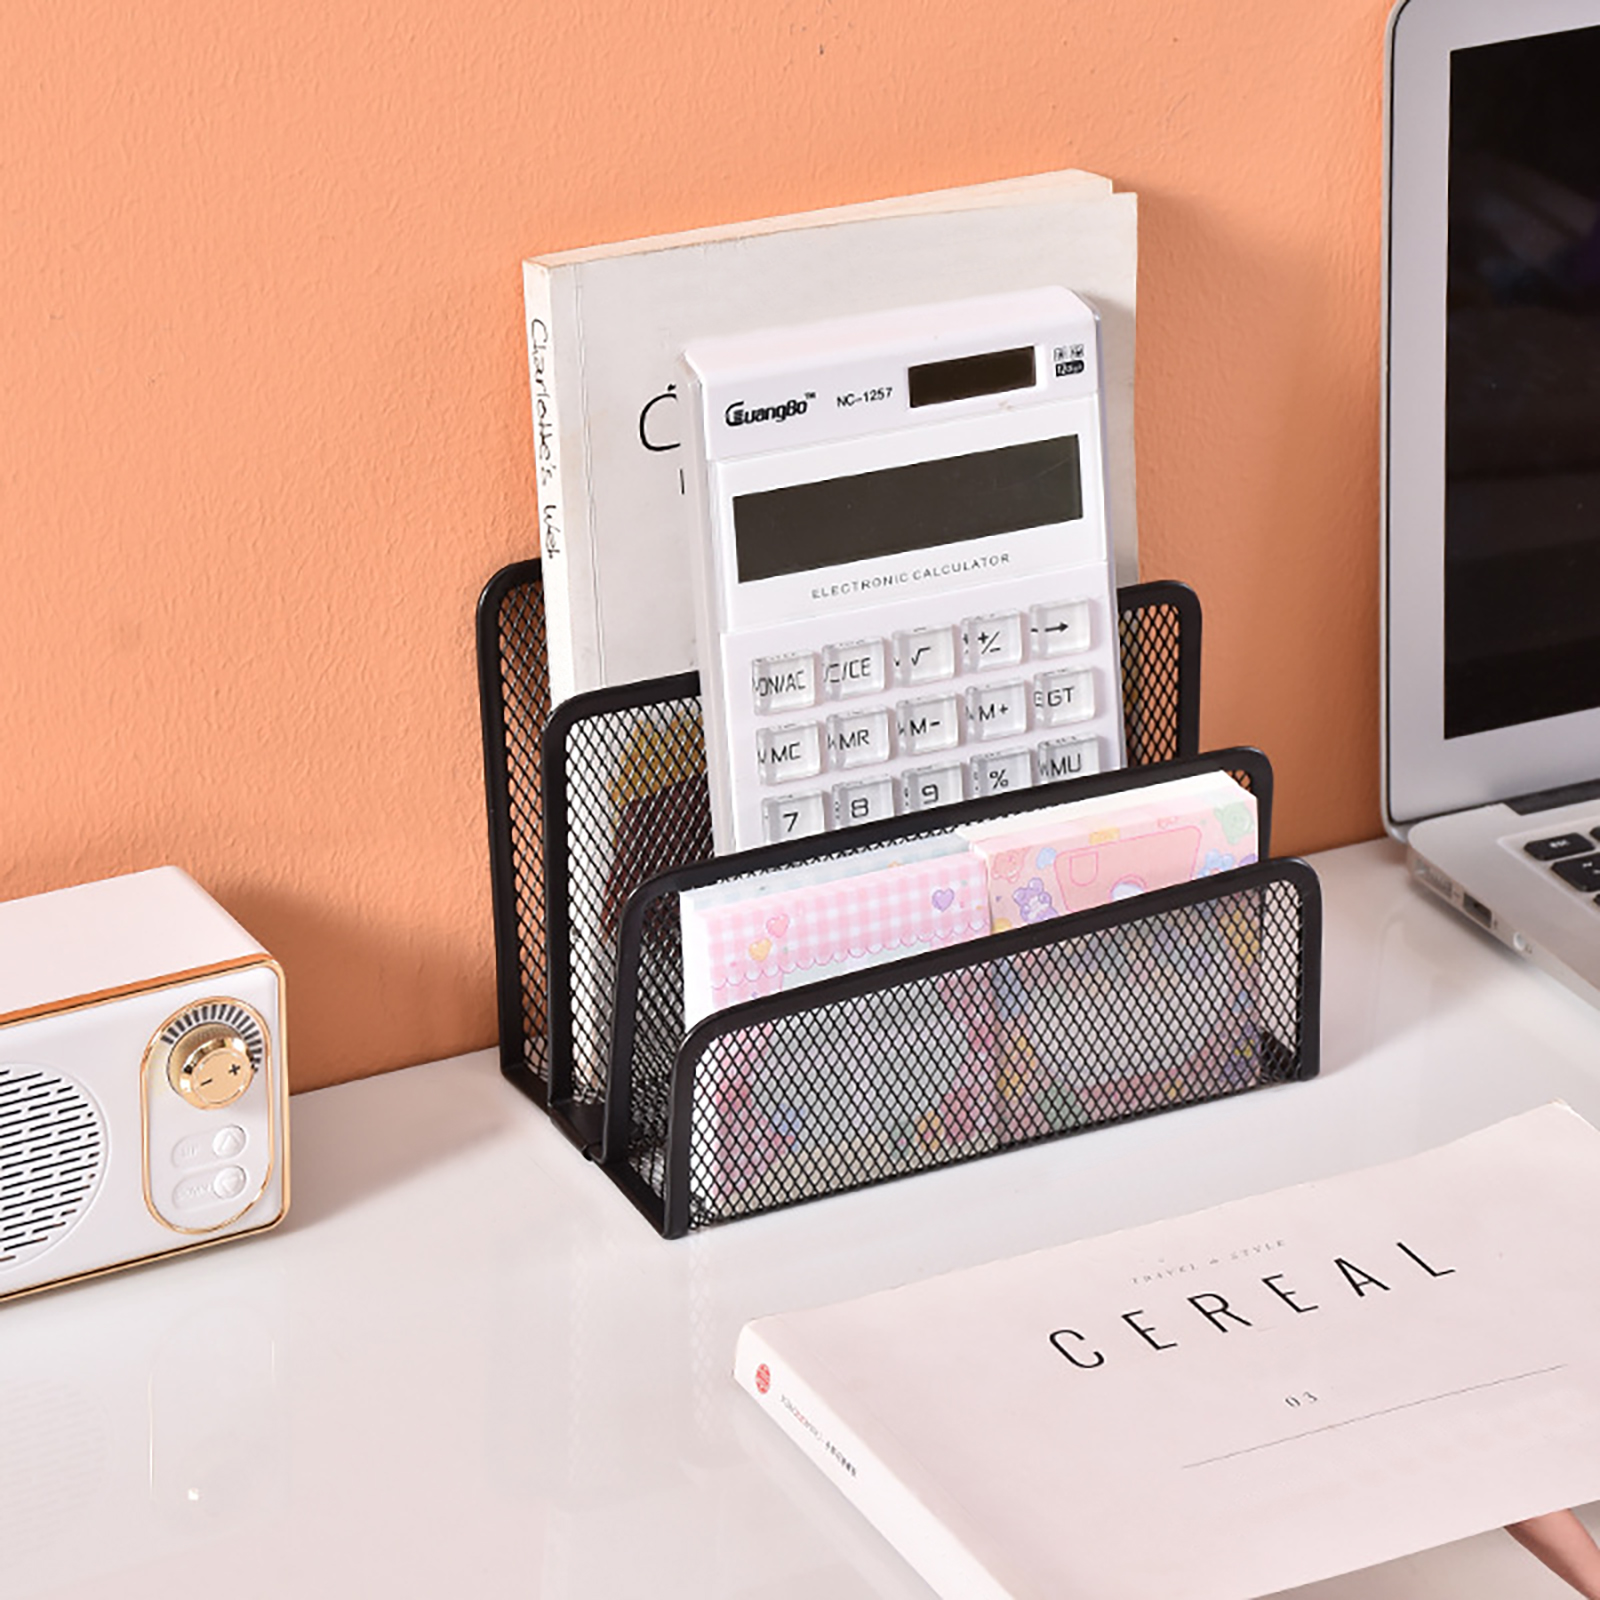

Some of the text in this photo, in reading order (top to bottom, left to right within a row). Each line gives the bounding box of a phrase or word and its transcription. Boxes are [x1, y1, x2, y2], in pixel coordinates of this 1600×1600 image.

[836, 386, 894, 409] NC-1257
[811, 553, 1011, 600] ELECTRONIC CALCULATOR
[1047, 686, 1076, 708] GT
[978, 703, 1009, 722] M+
[910, 716, 942, 736] M-
[838, 728, 871, 751] MR
[771, 741, 802, 764] MC
[1049, 753, 1083, 778] MU
[921, 784, 940, 805] 9
[850, 797, 870, 818] 8
[782, 811, 800, 833] 7
[1048, 1241, 1457, 1369] CEREAL
[1284, 1391, 1319, 1409] 03
